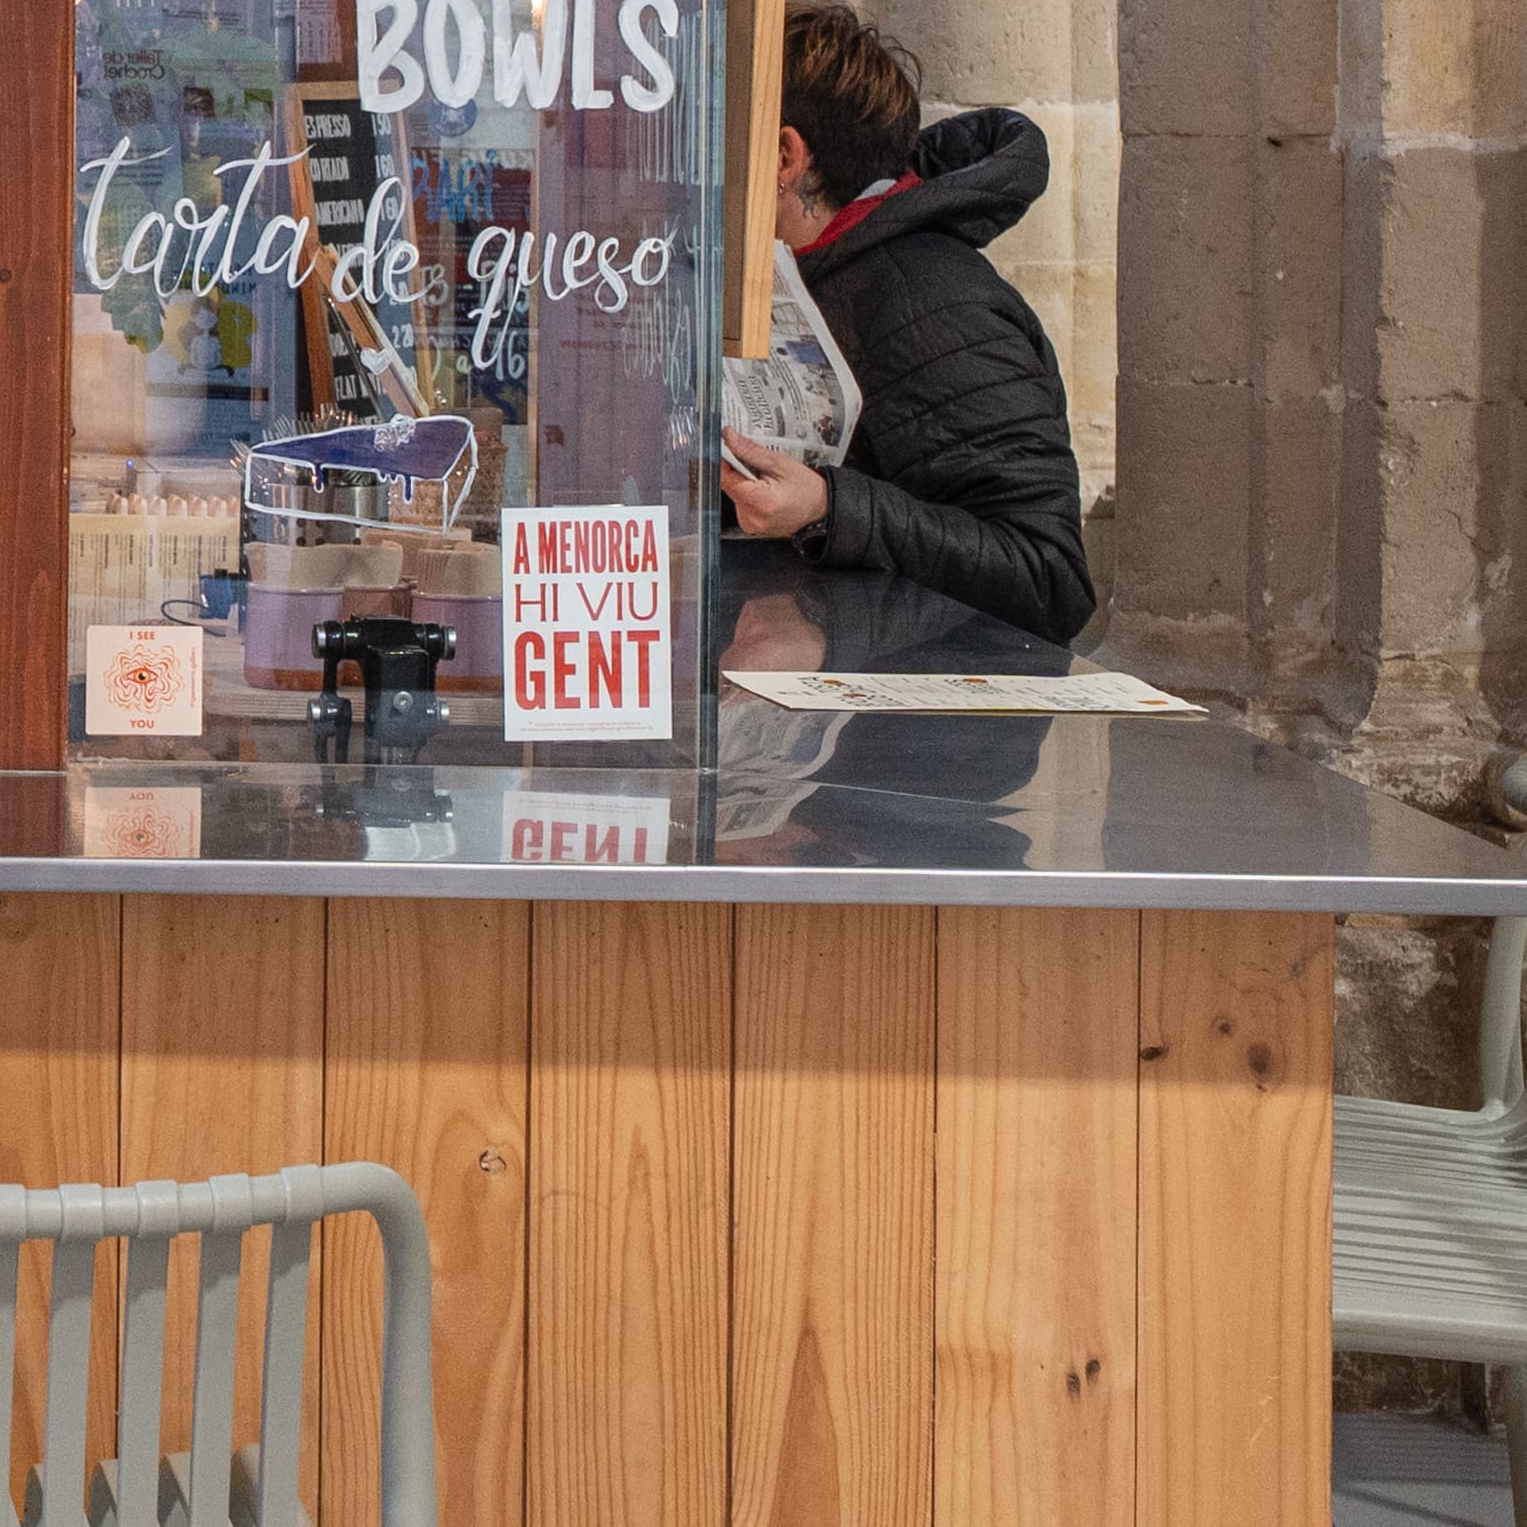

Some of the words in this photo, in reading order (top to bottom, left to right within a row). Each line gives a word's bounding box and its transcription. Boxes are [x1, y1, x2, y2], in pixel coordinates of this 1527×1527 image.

[79, 135, 323, 299] tarta
[330, 176, 430, 306] de
[467, 226, 676, 372] queso
[512, 521, 531, 575] A
[537, 519, 659, 575] MENORCA
[513, 582, 560, 623] HI
[577, 580, 658, 622] VIU
[136, 630, 156, 641] SEE
[513, 630, 661, 713] GENT
[129, 719, 156, 729] YOU
